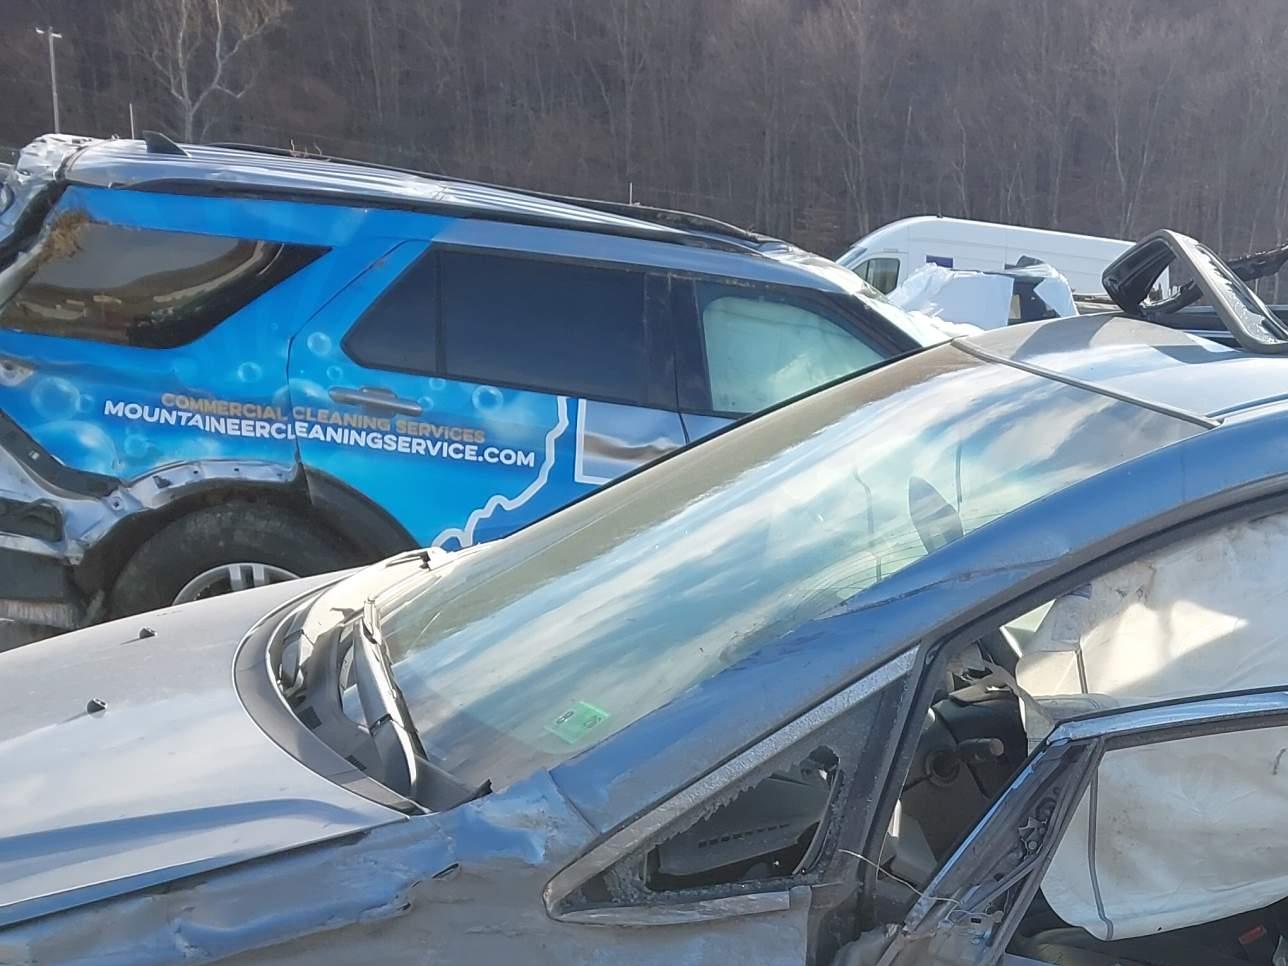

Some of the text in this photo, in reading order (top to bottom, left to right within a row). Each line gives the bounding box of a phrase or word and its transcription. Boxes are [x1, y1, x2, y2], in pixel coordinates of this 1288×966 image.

[104, 400, 535, 467] MOUNTAINEERCLEANINGSERVICE.COM
[161, 392, 486, 444] COMMERCIAL CLEANING SERVICES
